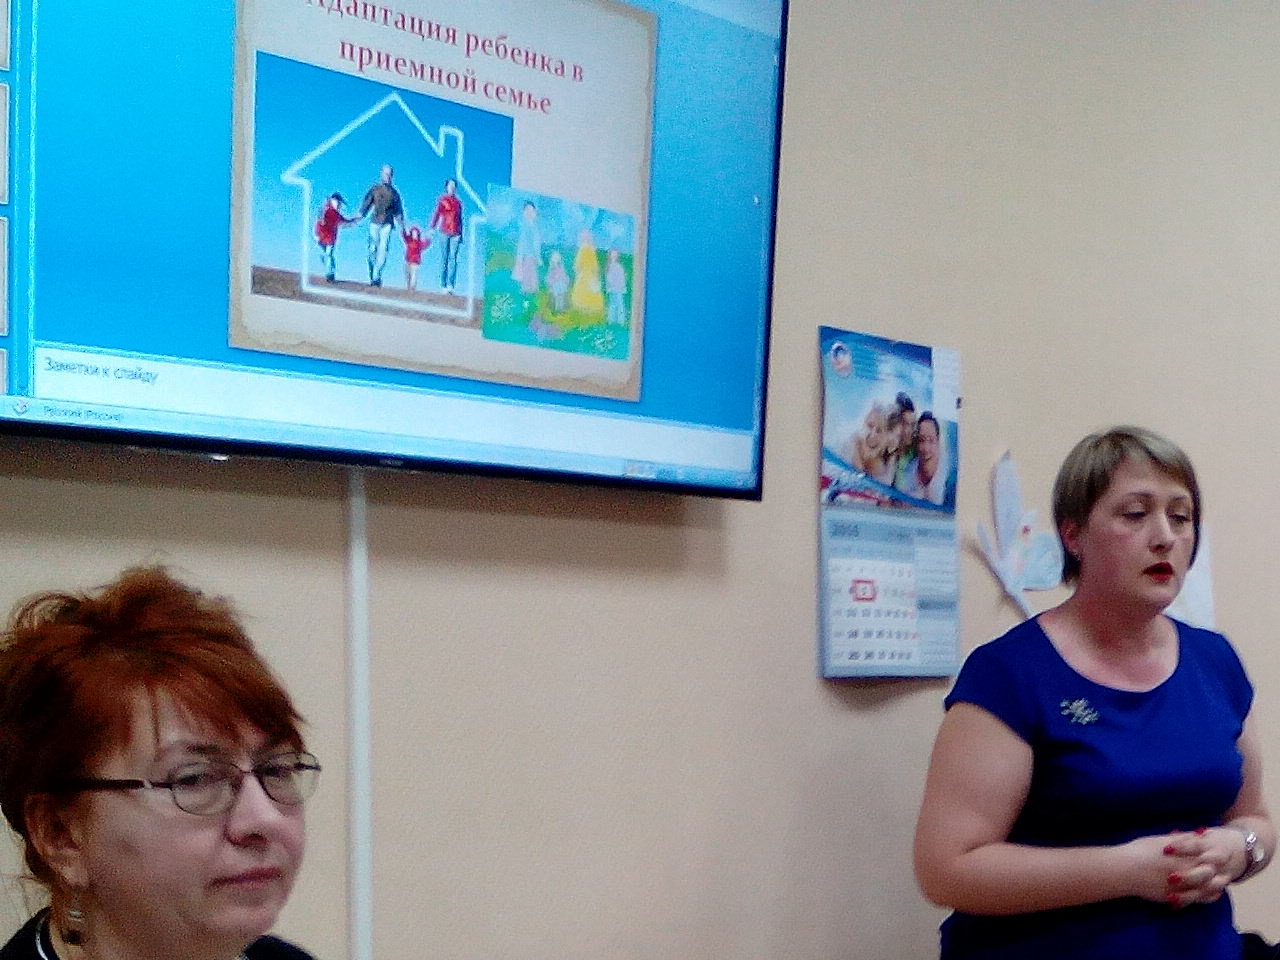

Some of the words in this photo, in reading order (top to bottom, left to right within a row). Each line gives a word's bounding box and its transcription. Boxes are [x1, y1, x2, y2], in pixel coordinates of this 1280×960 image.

[339, 40, 477, 95] приемной
[482, 81, 551, 114] семье
[464, 32, 566, 78] ребенка
[571, 63, 584, 82] в
[44, 356, 98, 376] Заметки
